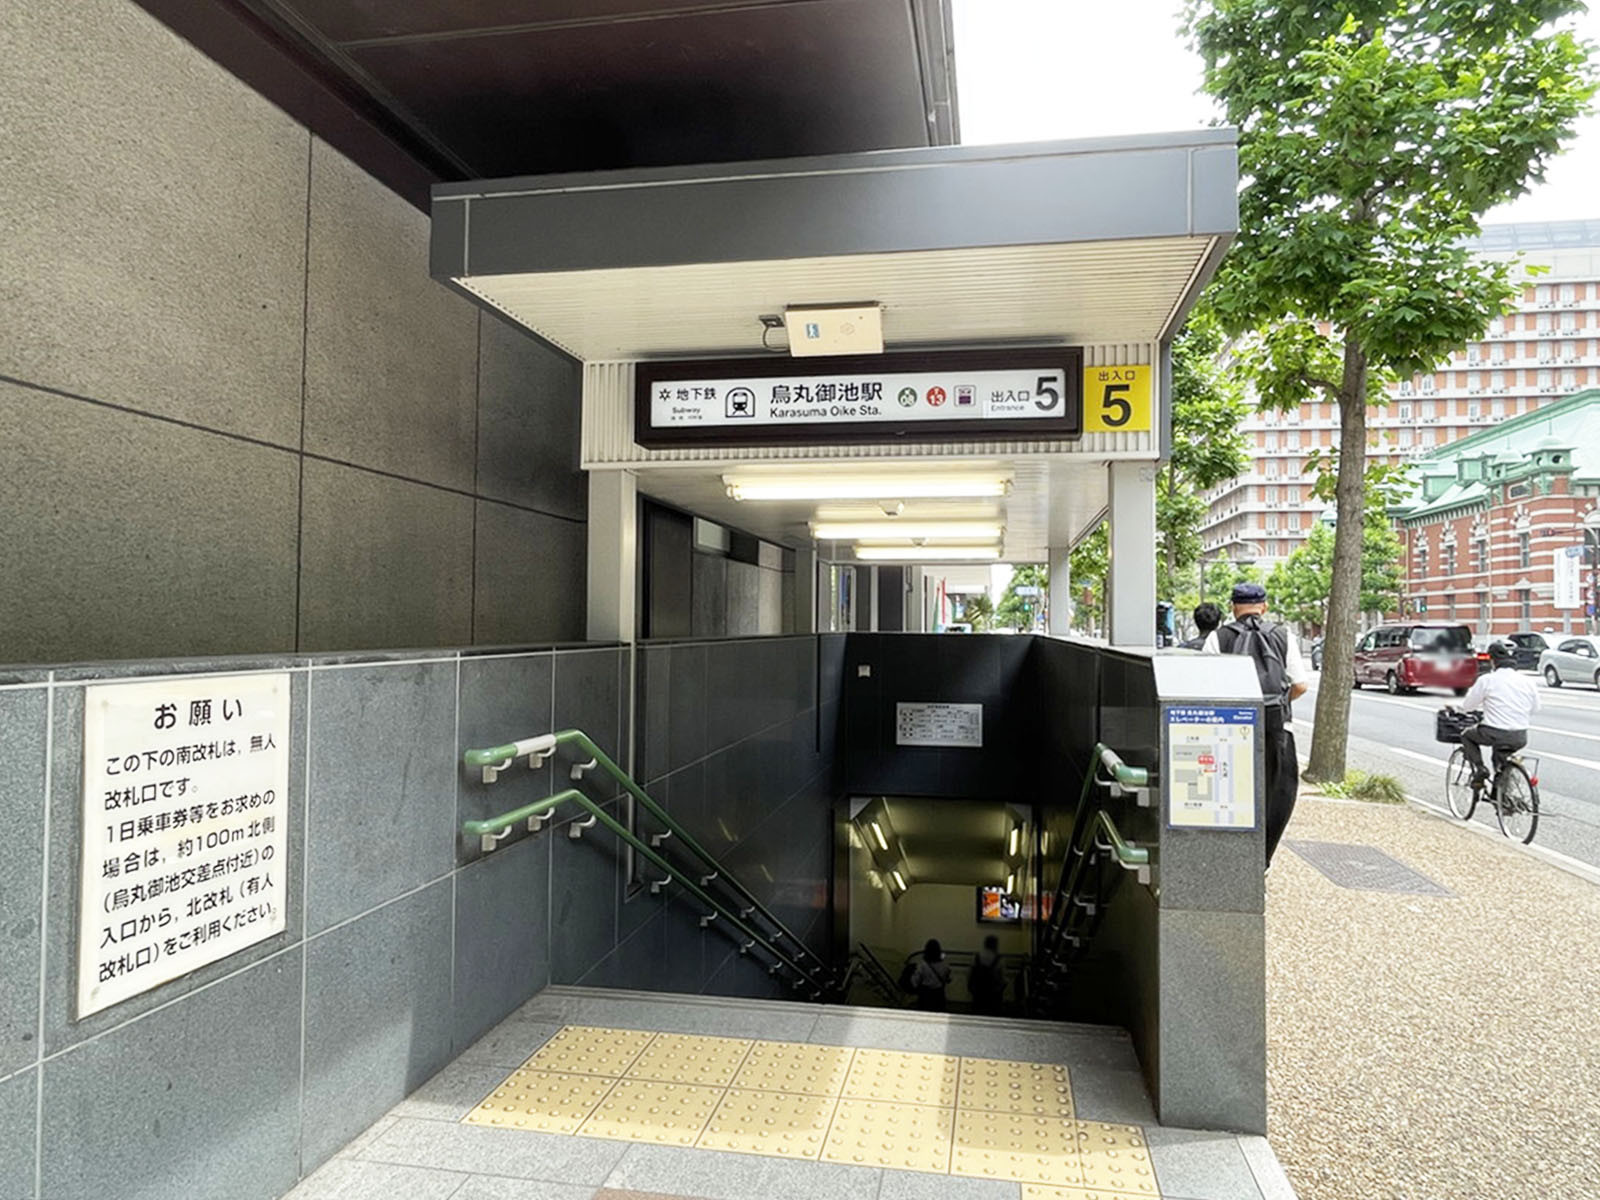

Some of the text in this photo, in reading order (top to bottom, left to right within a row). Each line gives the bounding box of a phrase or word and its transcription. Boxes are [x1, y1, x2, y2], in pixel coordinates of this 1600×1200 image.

[1098, 369, 1136, 382] 出入口
[676, 387, 717, 401] 地下鉄
[770, 382, 883, 404] 烏丸御池駅
[929, 394, 944, 404] 13
[991, 376, 1058, 411] 出入口 5
[770, 404, 882, 418] Karasuma Oike Sta.
[991, 404, 1025, 412] Entrance
[1101, 384, 1132, 427] 5
[153, 699, 242, 730] お願い
[104, 777, 199, 811] 改札口です。
[107, 789, 275, 843] 1日乗車券等をお求めの
